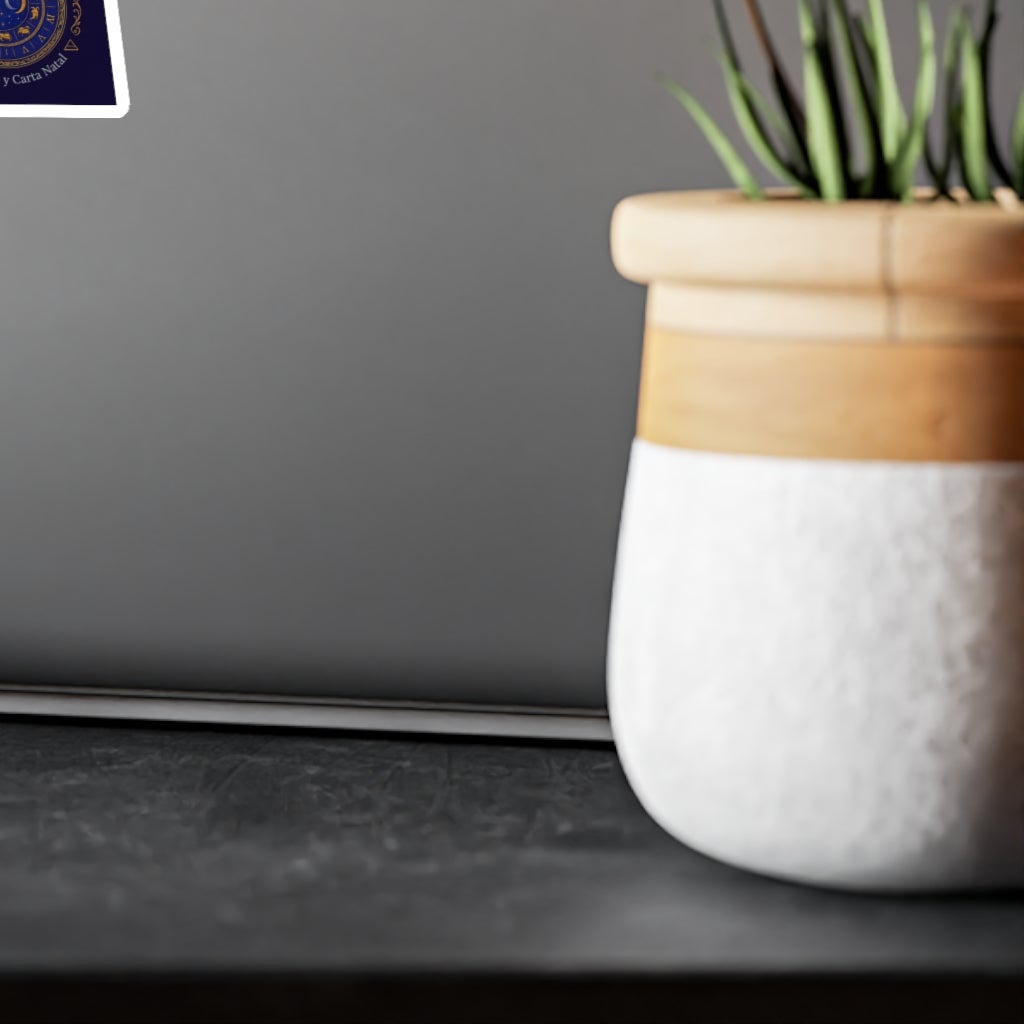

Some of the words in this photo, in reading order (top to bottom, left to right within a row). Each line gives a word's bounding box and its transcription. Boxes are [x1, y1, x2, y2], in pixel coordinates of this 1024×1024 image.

[3, 75, 10, 87] y
[12, 72, 42, 85] Carta
[41, 52, 68, 77] Natal
